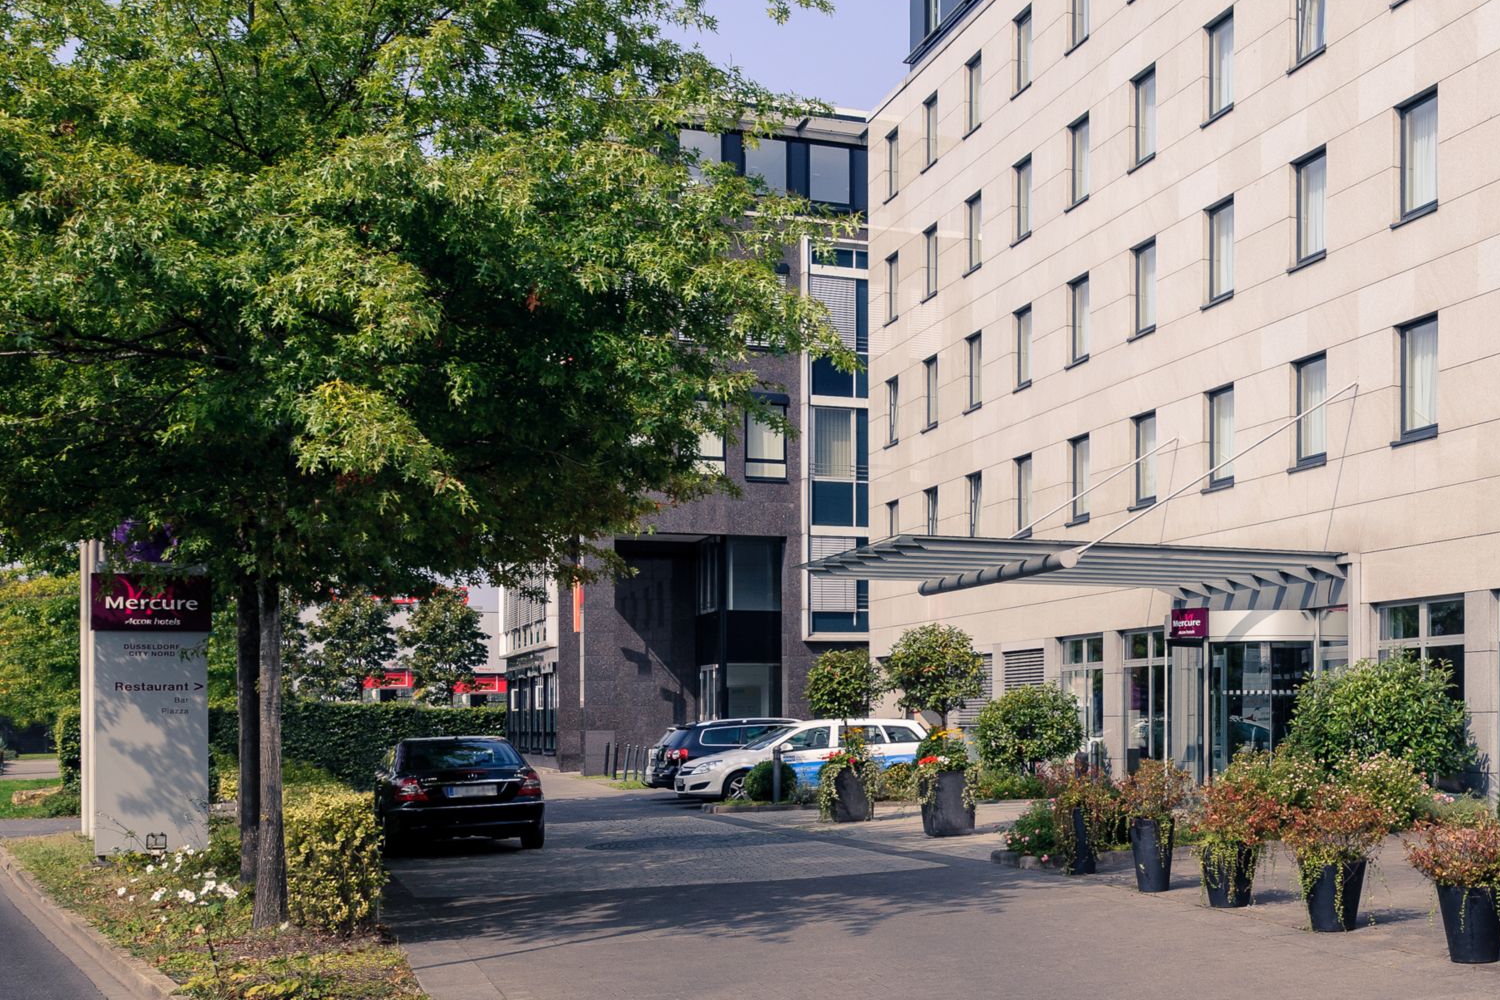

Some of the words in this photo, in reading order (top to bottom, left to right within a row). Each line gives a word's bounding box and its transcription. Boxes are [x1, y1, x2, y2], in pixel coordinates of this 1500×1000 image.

[105, 596, 198, 610] Mercure
[153, 617, 181, 625] hotels
[115, 681, 189, 692] Restaurant
